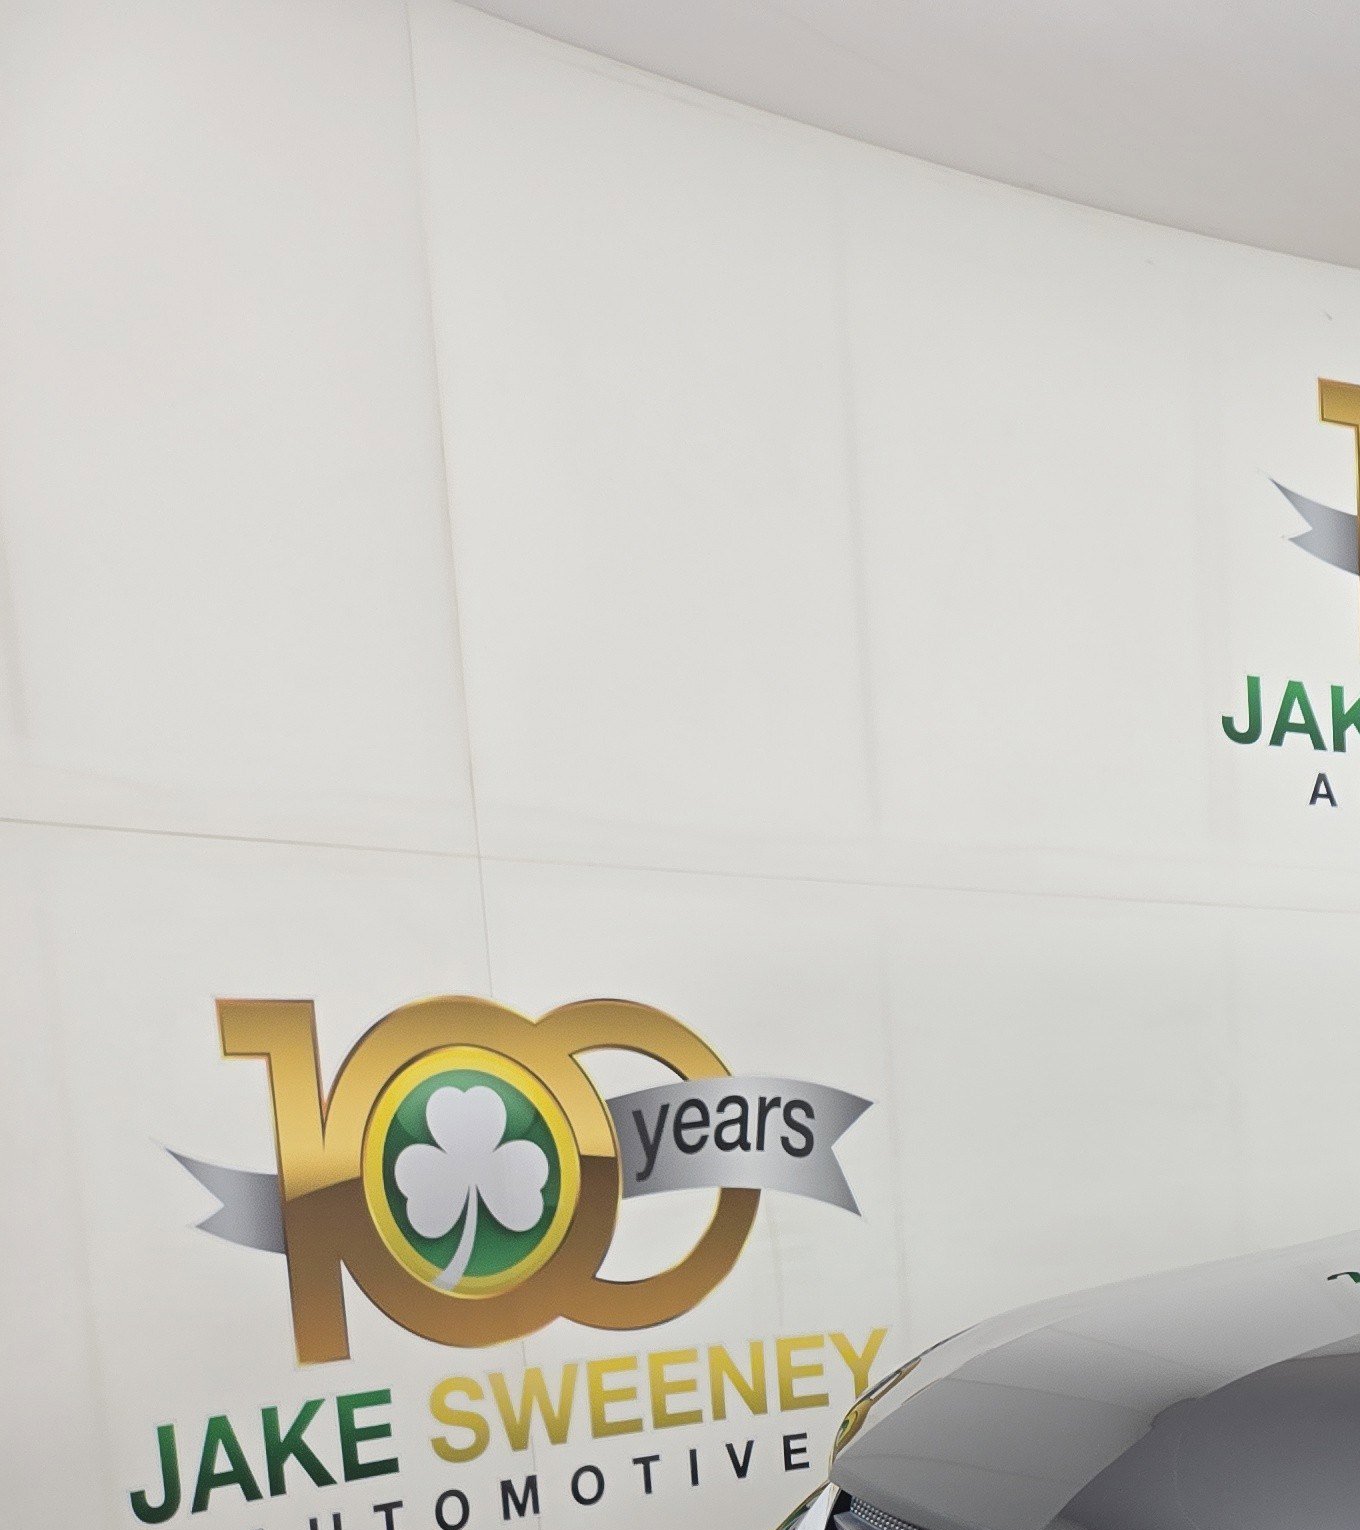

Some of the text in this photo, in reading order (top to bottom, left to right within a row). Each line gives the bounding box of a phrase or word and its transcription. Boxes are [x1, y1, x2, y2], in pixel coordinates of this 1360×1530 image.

[215, 995, 816, 1368] 100 years
[127, 1328, 888, 1524] JAKE SWEENEY
